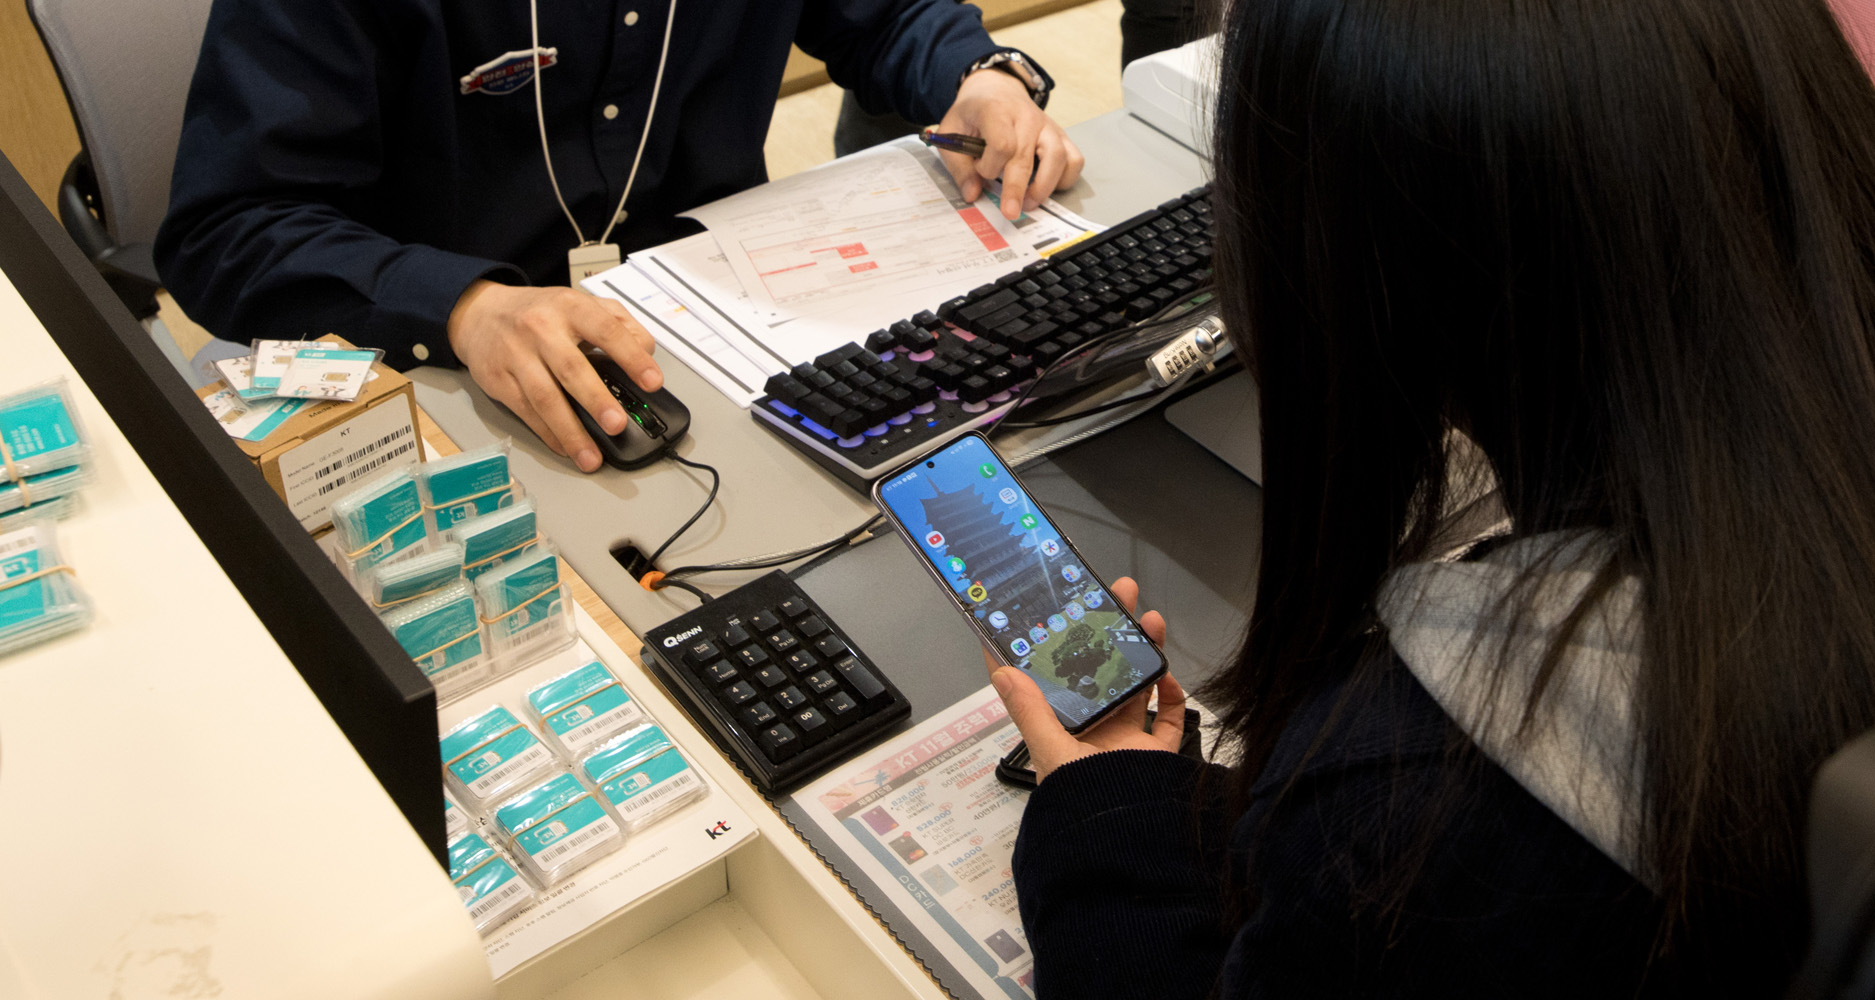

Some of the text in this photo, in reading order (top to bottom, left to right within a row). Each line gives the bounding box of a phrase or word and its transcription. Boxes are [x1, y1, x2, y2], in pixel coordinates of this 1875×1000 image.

[340, 426, 351, 437] KT
[663, 625, 702, 648] QSENN
[801, 711, 812, 721] 00
[894, 749, 919, 768] KT
[918, 730, 955, 756] 11월
[953, 711, 989, 737] 주력
[705, 821, 731, 840] kt
